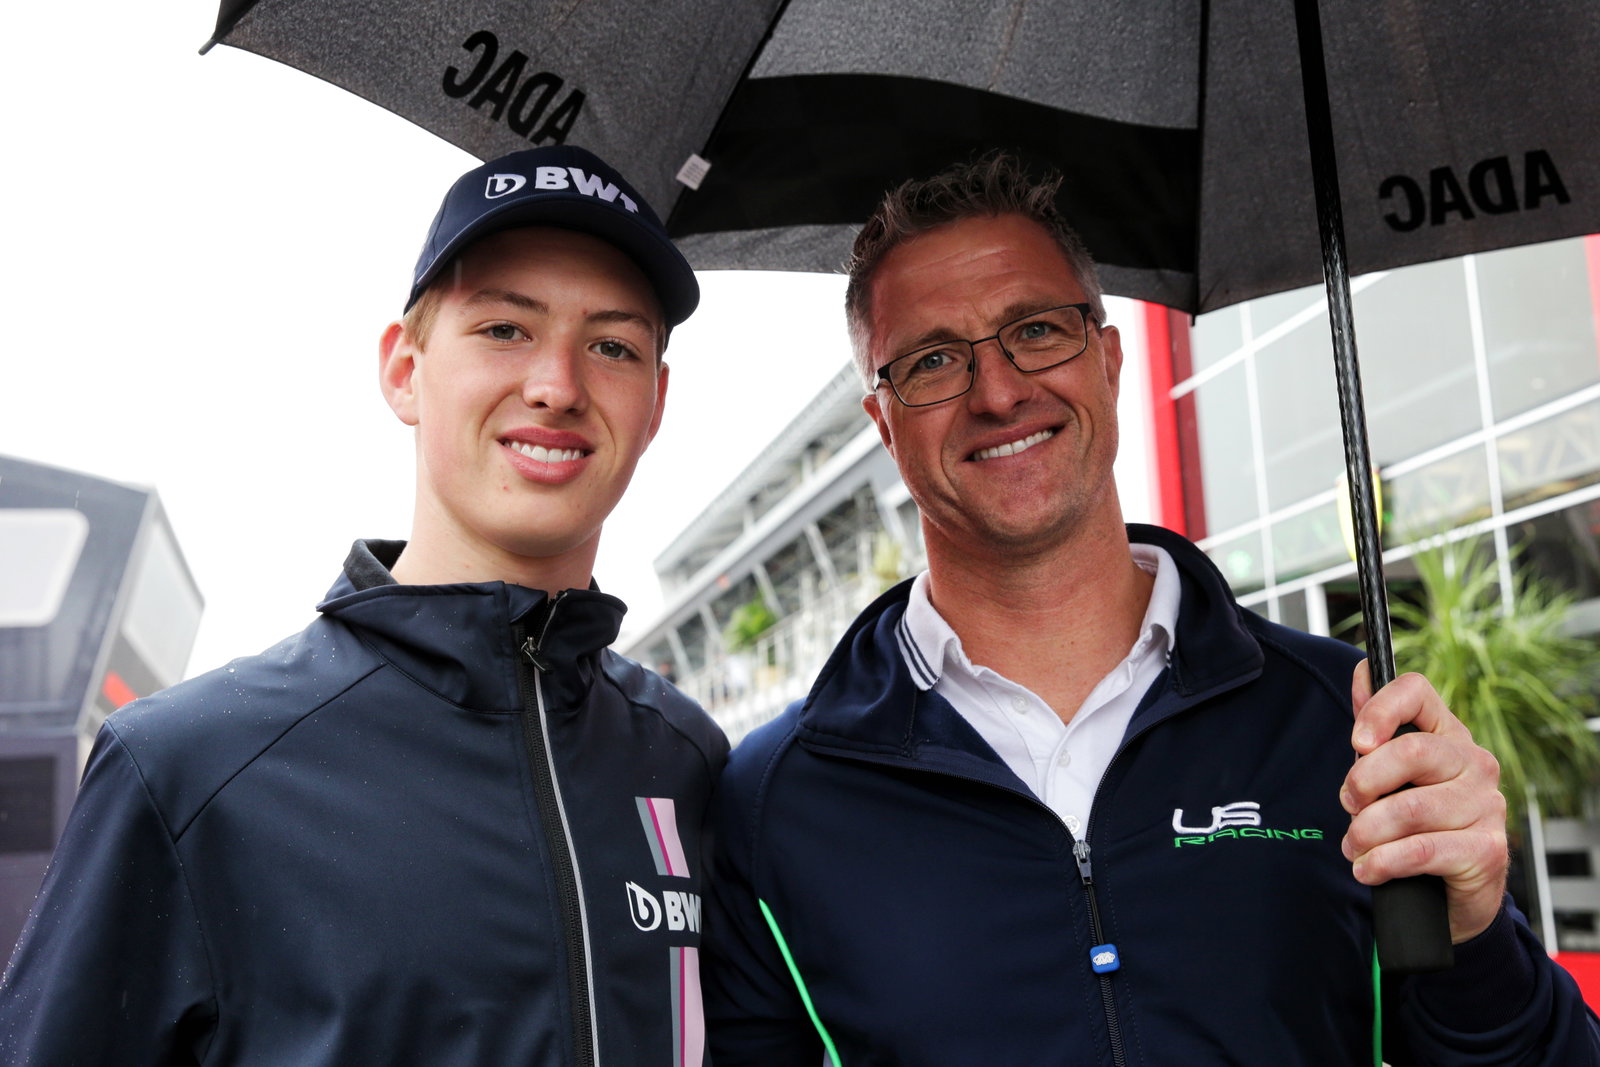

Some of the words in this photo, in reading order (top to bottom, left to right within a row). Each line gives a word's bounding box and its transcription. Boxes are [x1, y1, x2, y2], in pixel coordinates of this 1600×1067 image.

[1172, 801, 1262, 834] US
[1174, 828, 1324, 848] RACING
[662, 890, 702, 936] BW
